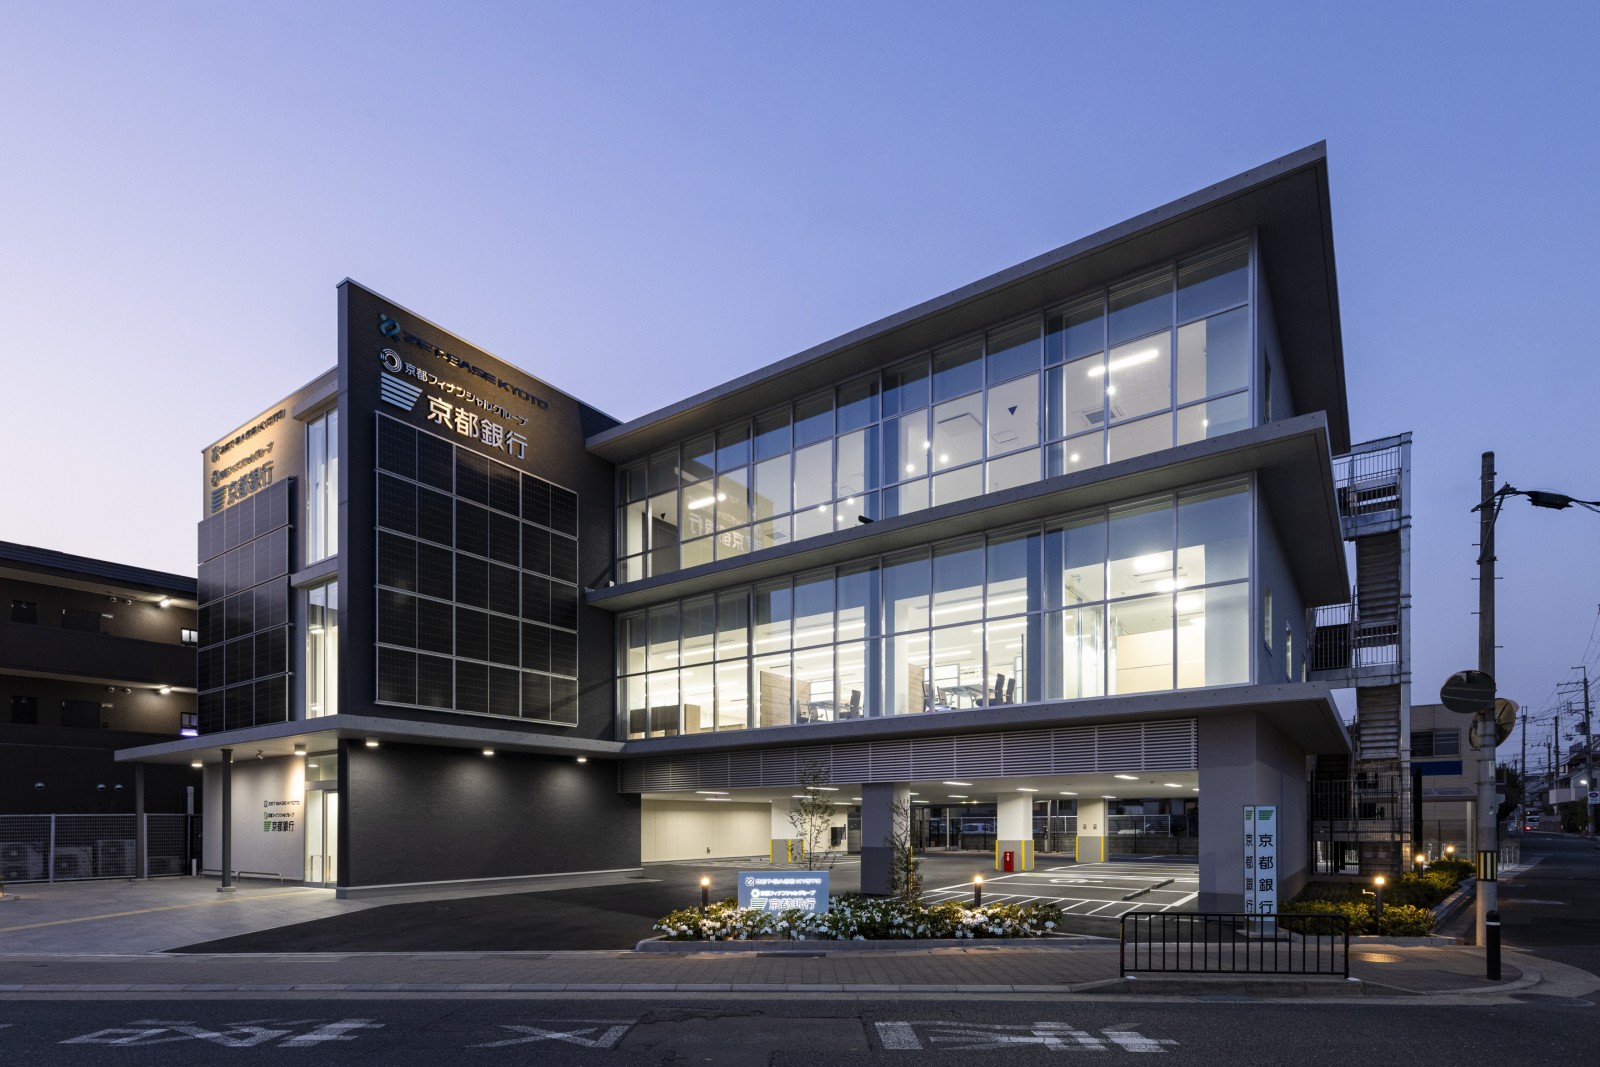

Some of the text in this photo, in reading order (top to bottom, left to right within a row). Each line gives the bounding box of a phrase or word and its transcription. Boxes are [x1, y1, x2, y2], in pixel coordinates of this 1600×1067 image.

[404, 361, 529, 426] 京都フィナンシャルグループ
[498, 378, 549, 410] KYOTO
[426, 394, 528, 460] 京都銀行
[272, 821, 294, 832] 京都銀行
[769, 898, 816, 911] 京都銀行
[1246, 834, 1254, 913] 京都銀行
[1259, 834, 1274, 914] 京都銀行
